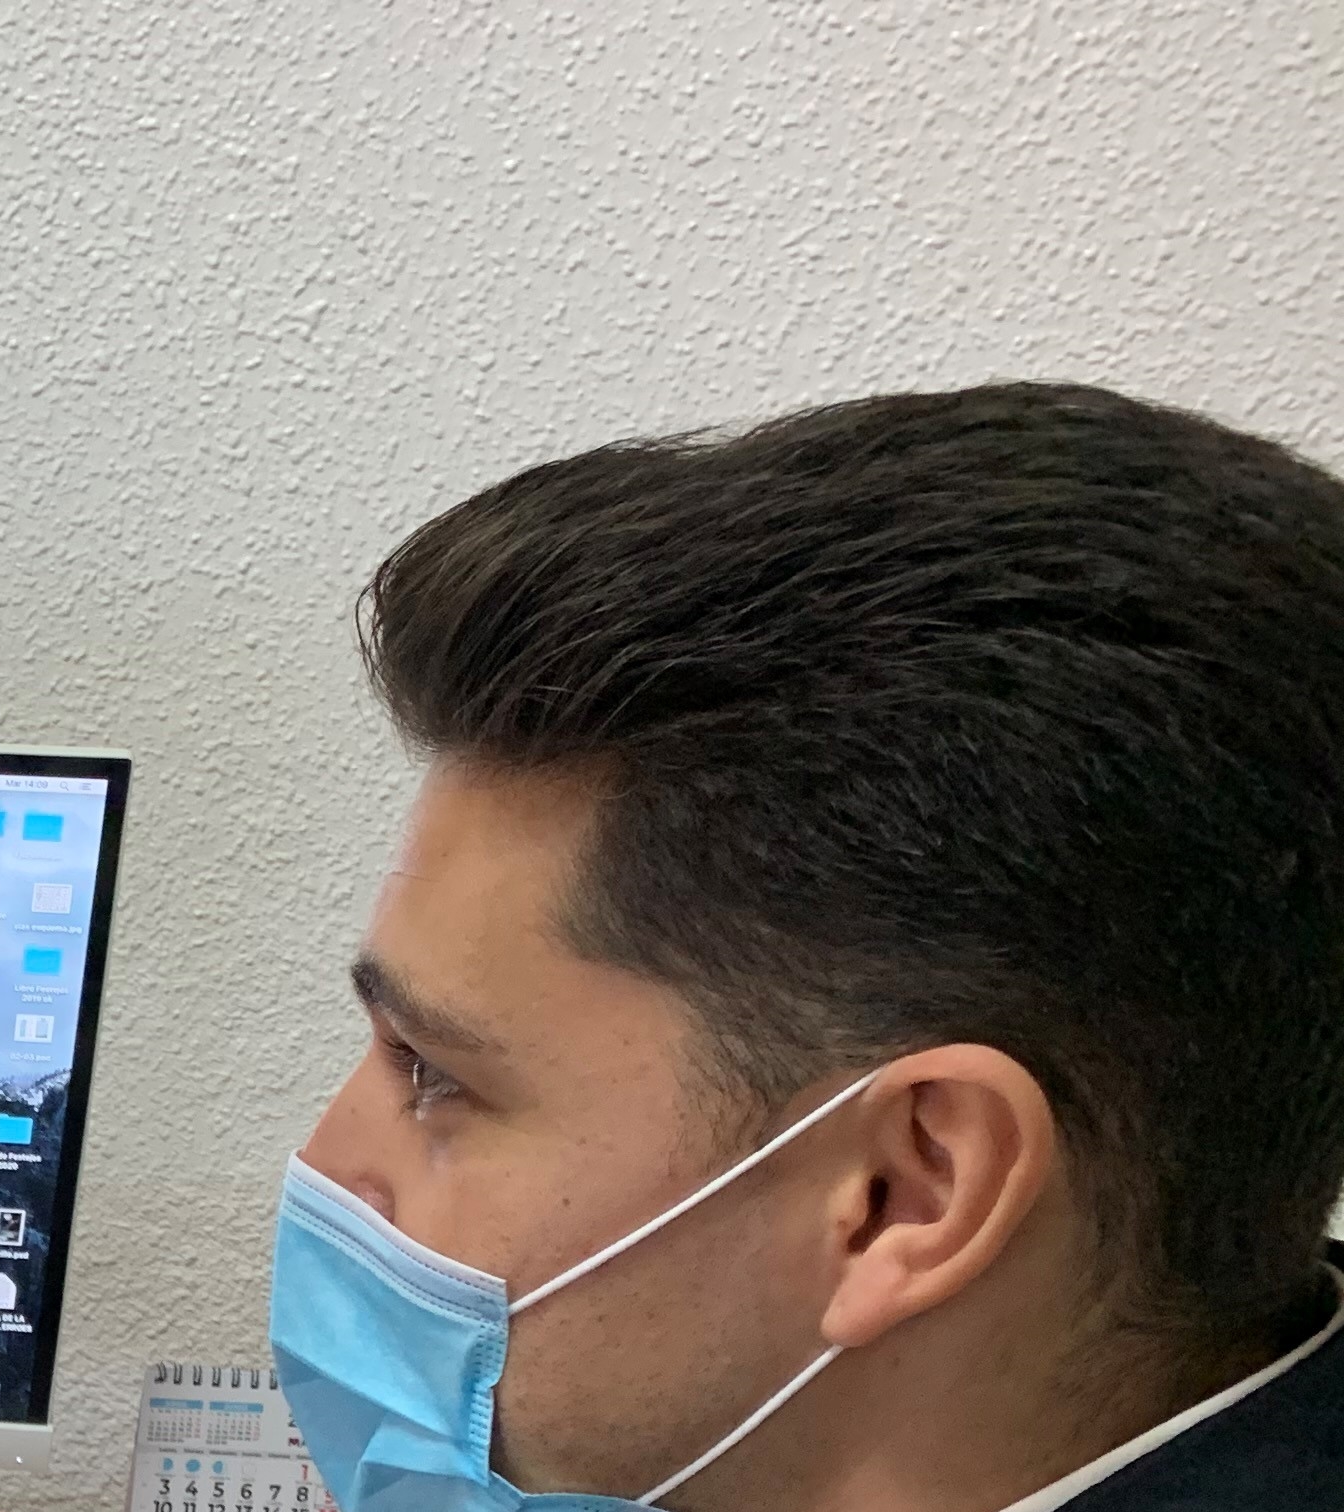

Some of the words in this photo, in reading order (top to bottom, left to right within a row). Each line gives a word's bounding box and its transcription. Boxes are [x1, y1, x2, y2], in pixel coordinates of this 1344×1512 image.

[300, 1463, 309, 1481] 1
[159, 1479, 171, 1496] 3
[185, 1481, 198, 1496] 4
[213, 1482, 225, 1498] 5
[240, 1484, 253, 1500] 6
[269, 1484, 282, 1500] 7
[296, 1486, 309, 1502] 8
